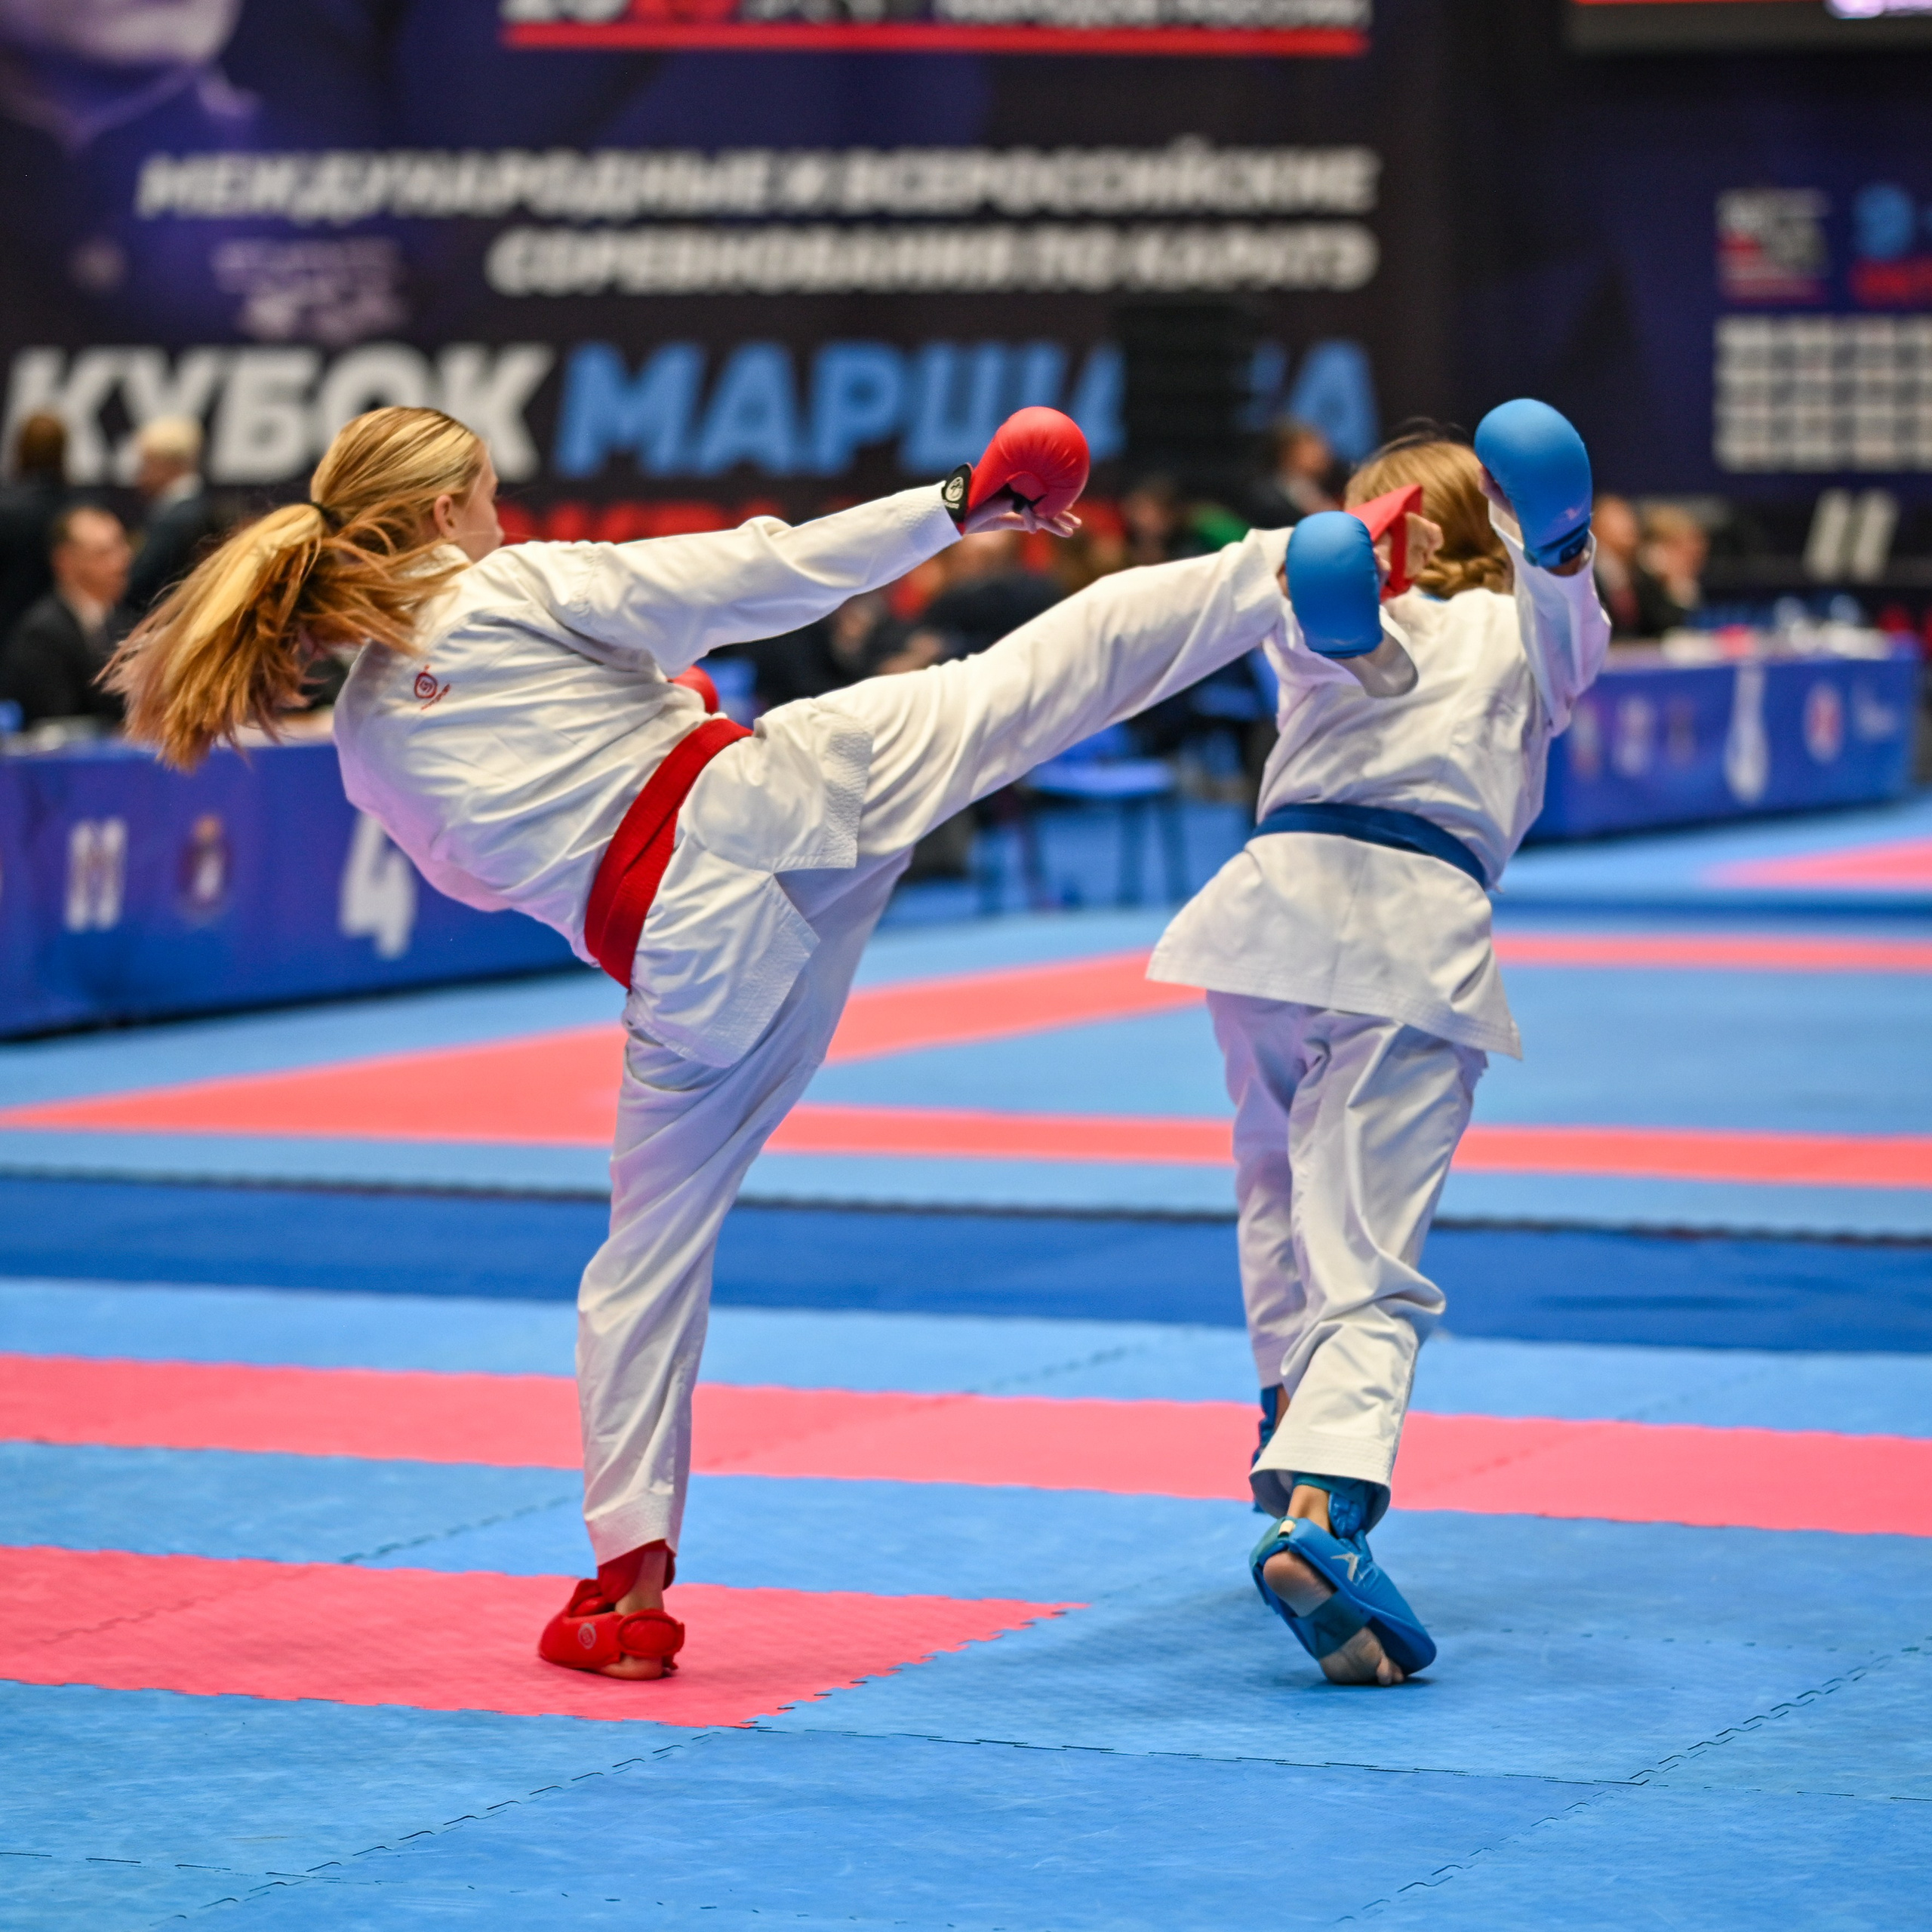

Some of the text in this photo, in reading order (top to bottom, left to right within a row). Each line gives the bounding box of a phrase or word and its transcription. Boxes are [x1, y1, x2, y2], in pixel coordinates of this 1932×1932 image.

[136, 149, 767, 225] МЕЖДУНАРОДНЫЕ
[838, 134, 1380, 217] ВСЕРОССИЙСКИЕ
[485, 228, 1015, 296] СОРЕВНОВАНИЯ
[1029, 228, 1117, 294] ПО
[8, 340, 1375, 483] КУБОК МАРША
